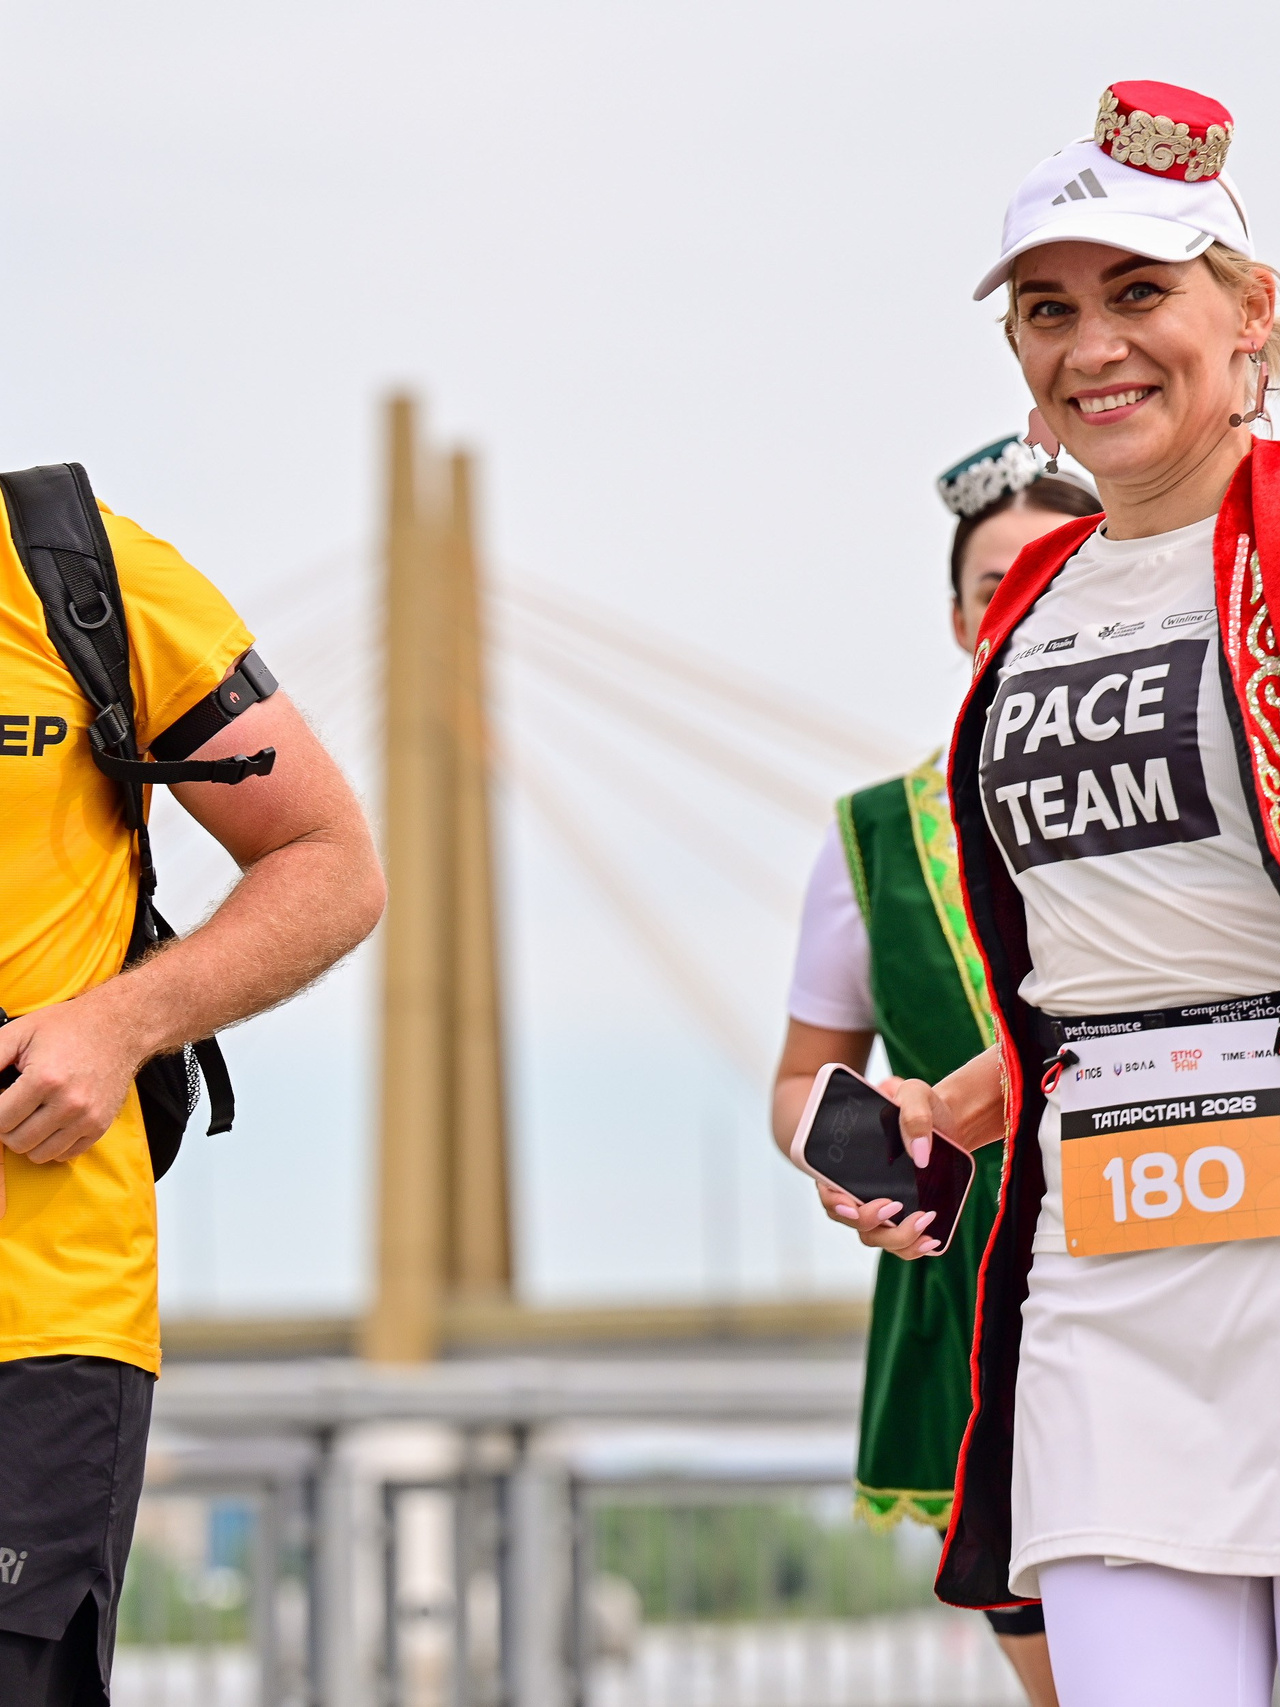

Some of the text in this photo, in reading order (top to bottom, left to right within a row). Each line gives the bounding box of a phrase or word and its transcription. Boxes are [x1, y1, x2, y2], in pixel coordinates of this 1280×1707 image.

[1167, 614, 1203, 626] Winline
[1020, 643, 1045, 659] СБЕР
[993, 663, 1170, 762] PACE
[995, 756, 1180, 847] TEAM
[1181, 995, 1271, 1016] compressport
[1064, 1021, 1142, 1040] performance
[1170, 1049, 1202, 1062] ЭТНО
[1084, 1067, 1102, 1080] ПСБ
[1125, 1060, 1156, 1073] ВФЛА
[1175, 1059, 1198, 1072] РАН
[1092, 1095, 1257, 1130] ТАТАРСТАН 2026
[1102, 1145, 1246, 1223] 180
